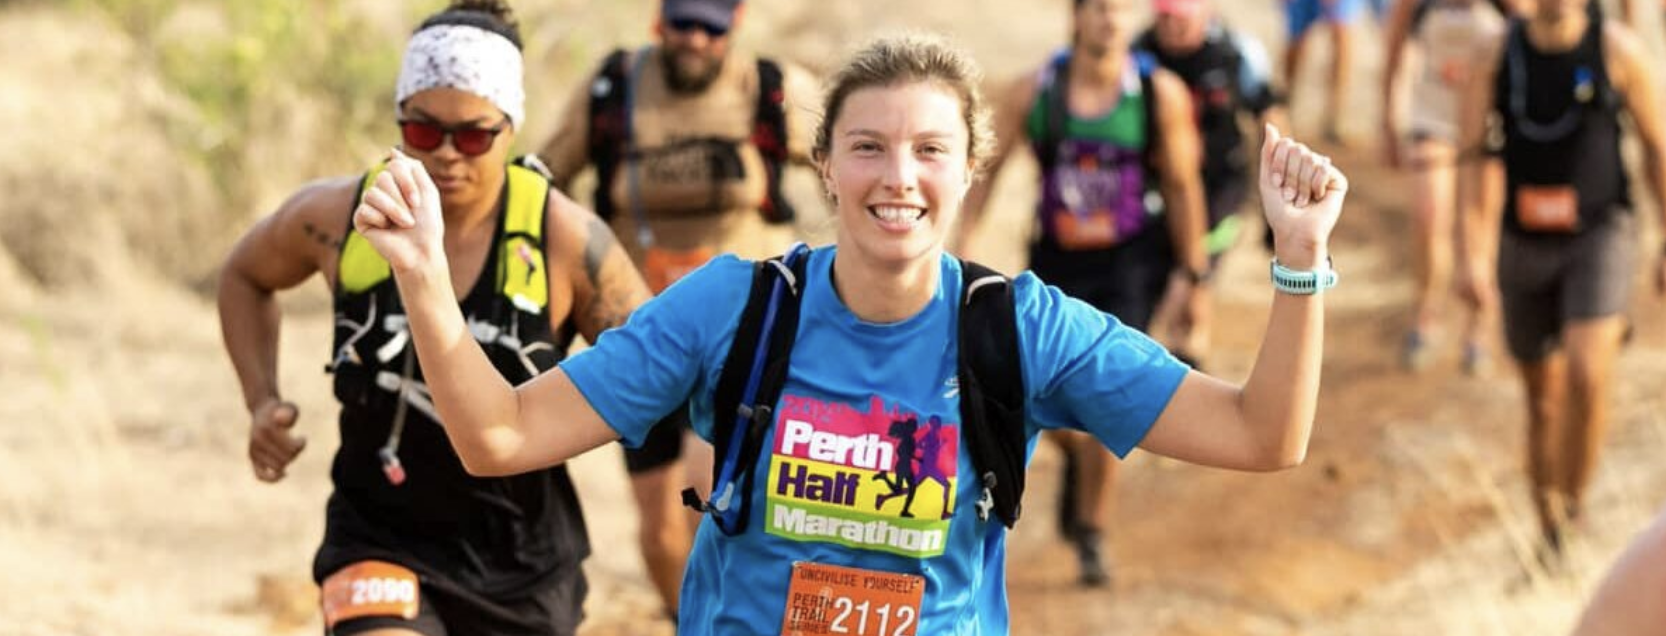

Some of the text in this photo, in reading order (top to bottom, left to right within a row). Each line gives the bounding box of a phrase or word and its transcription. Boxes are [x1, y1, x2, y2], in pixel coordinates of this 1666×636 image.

[781, 419, 893, 471] Perth
[777, 462, 861, 506] Half
[773, 505, 942, 551] Marathon
[792, 607, 827, 622] TRAIL
[794, 592, 834, 609] PERTH
[831, 597, 915, 636] 2112
